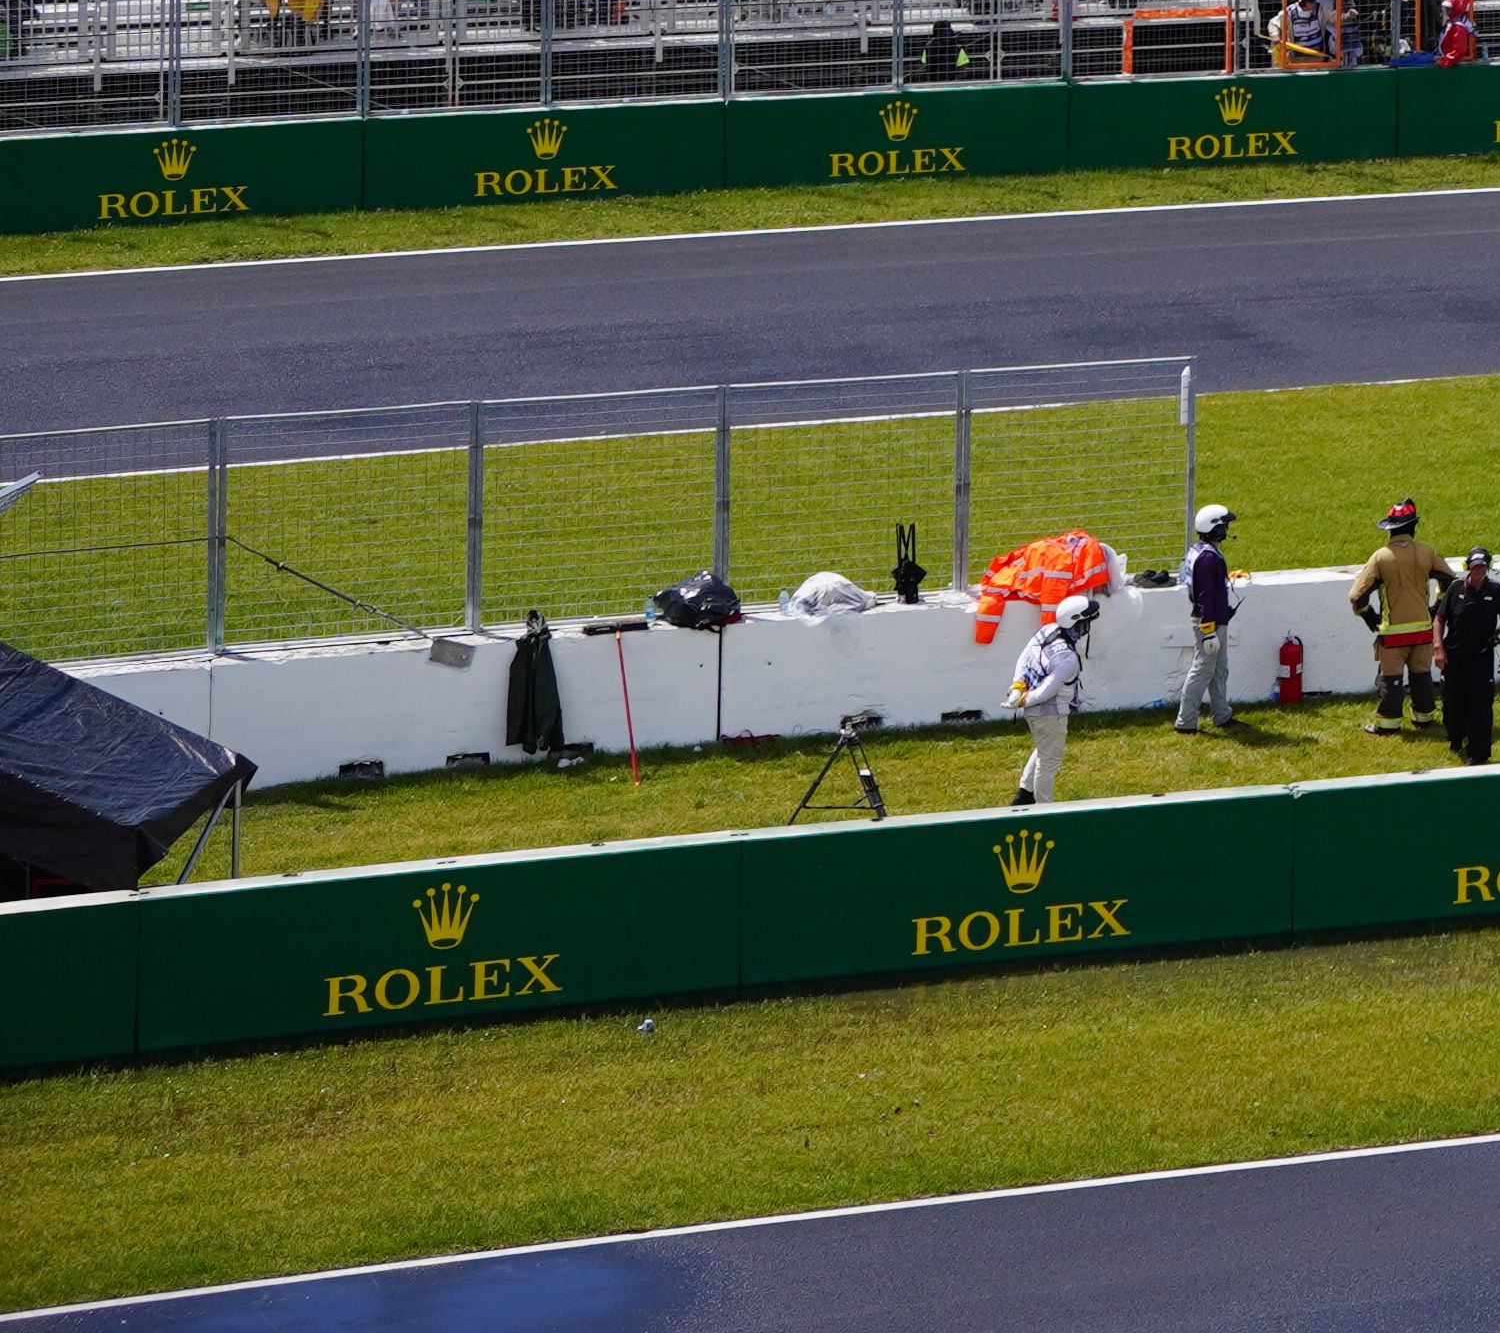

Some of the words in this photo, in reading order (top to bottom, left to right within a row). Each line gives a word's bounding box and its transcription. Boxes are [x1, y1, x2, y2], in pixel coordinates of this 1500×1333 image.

[1166, 132, 1298, 160] ROLEX
[829, 147, 965, 178] ROLEX
[475, 165, 617, 197] ROLEX
[98, 188, 248, 220] ROLEX
[911, 899, 1129, 957] ROLEX
[321, 952, 563, 1018] ROLEX
